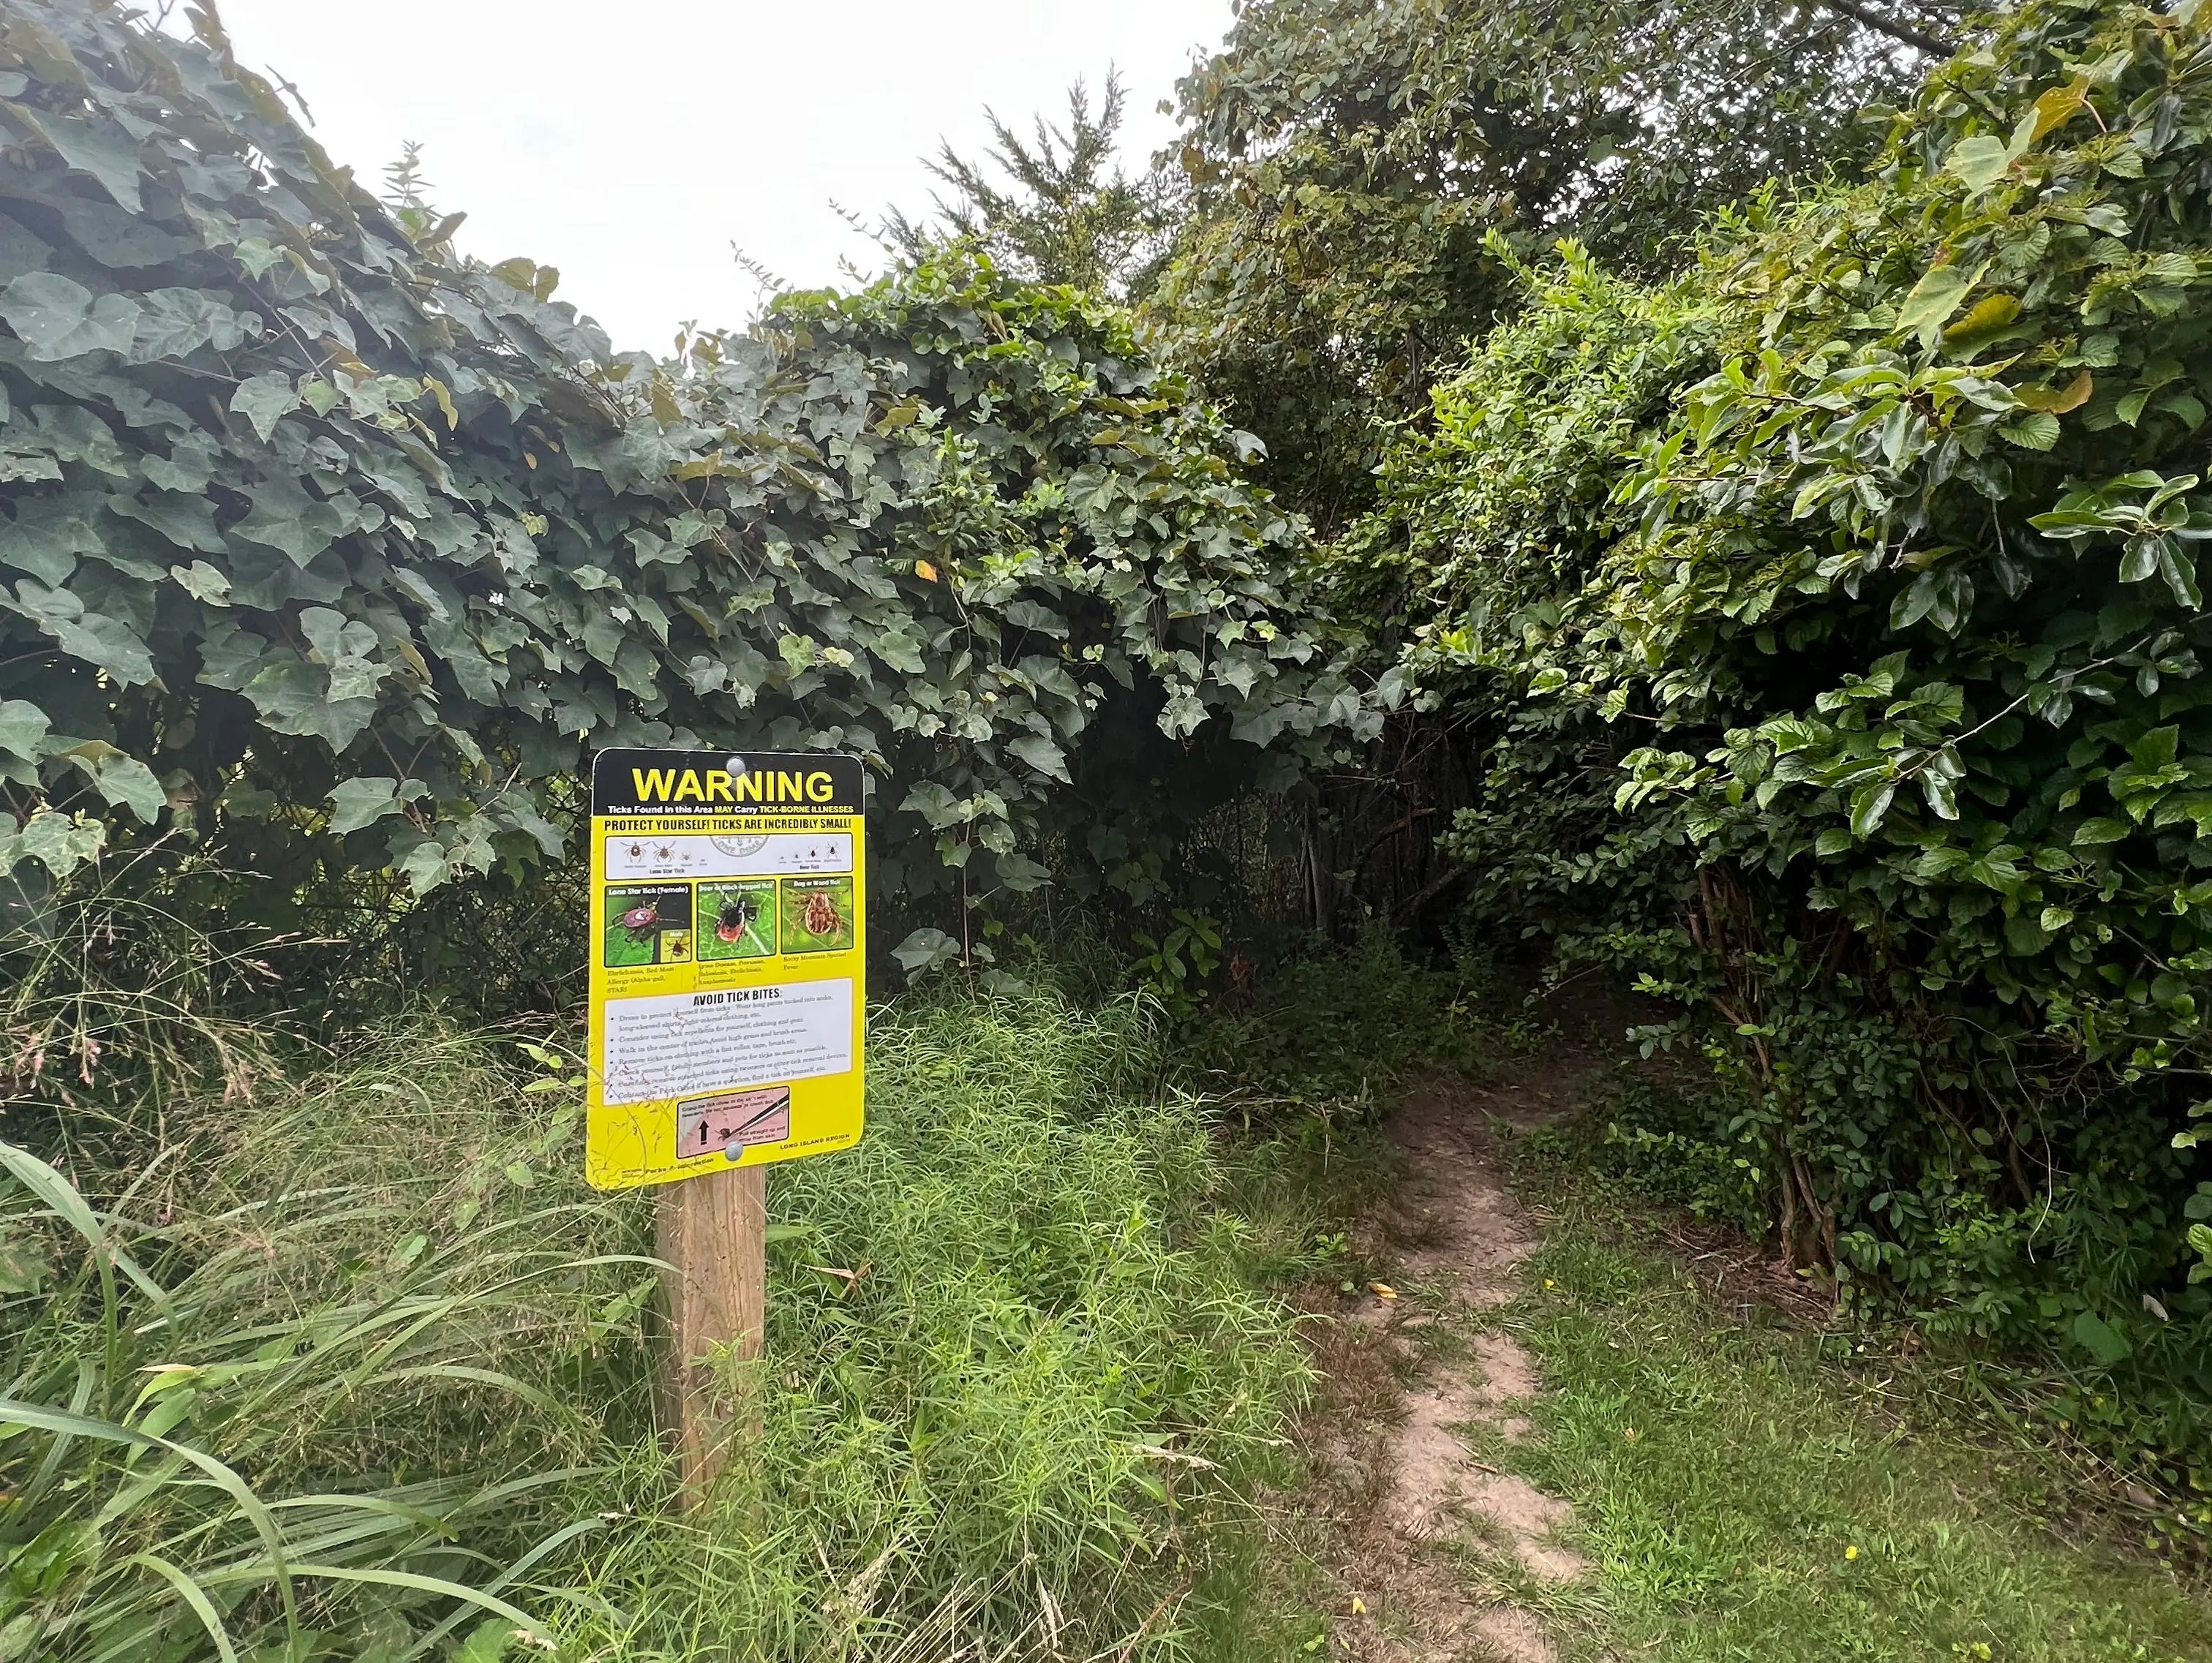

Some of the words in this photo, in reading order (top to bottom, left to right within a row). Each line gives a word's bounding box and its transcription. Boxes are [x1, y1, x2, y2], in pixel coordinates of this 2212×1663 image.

[632, 768, 833, 802] WARNING
[734, 806, 757, 815] Carry
[604, 821, 653, 831] PROTECT
[656, 820, 710, 830] YOURSELF!
[712, 820, 742, 829] TICKS
[744, 819, 762, 829] ARE
[764, 818, 818, 829] INCREDIBLY
[820, 818, 851, 828] SMALL!
[718, 842, 736, 854] ONE
[740, 841, 762, 854] DIME
[658, 886, 689, 894] (Female)
[693, 994, 723, 1006] AVOID
[727, 991, 749, 1003] TICK
[753, 988, 783, 1000] BITES:
[649, 1012, 672, 1020] protect
[753, 1019, 777, 1027] clothing
[674, 1051, 699, 1059] clothing
[693, 1059, 721, 1067] members
[800, 1138, 824, 1146] ISLAND
[826, 1134, 850, 1142] REGION
